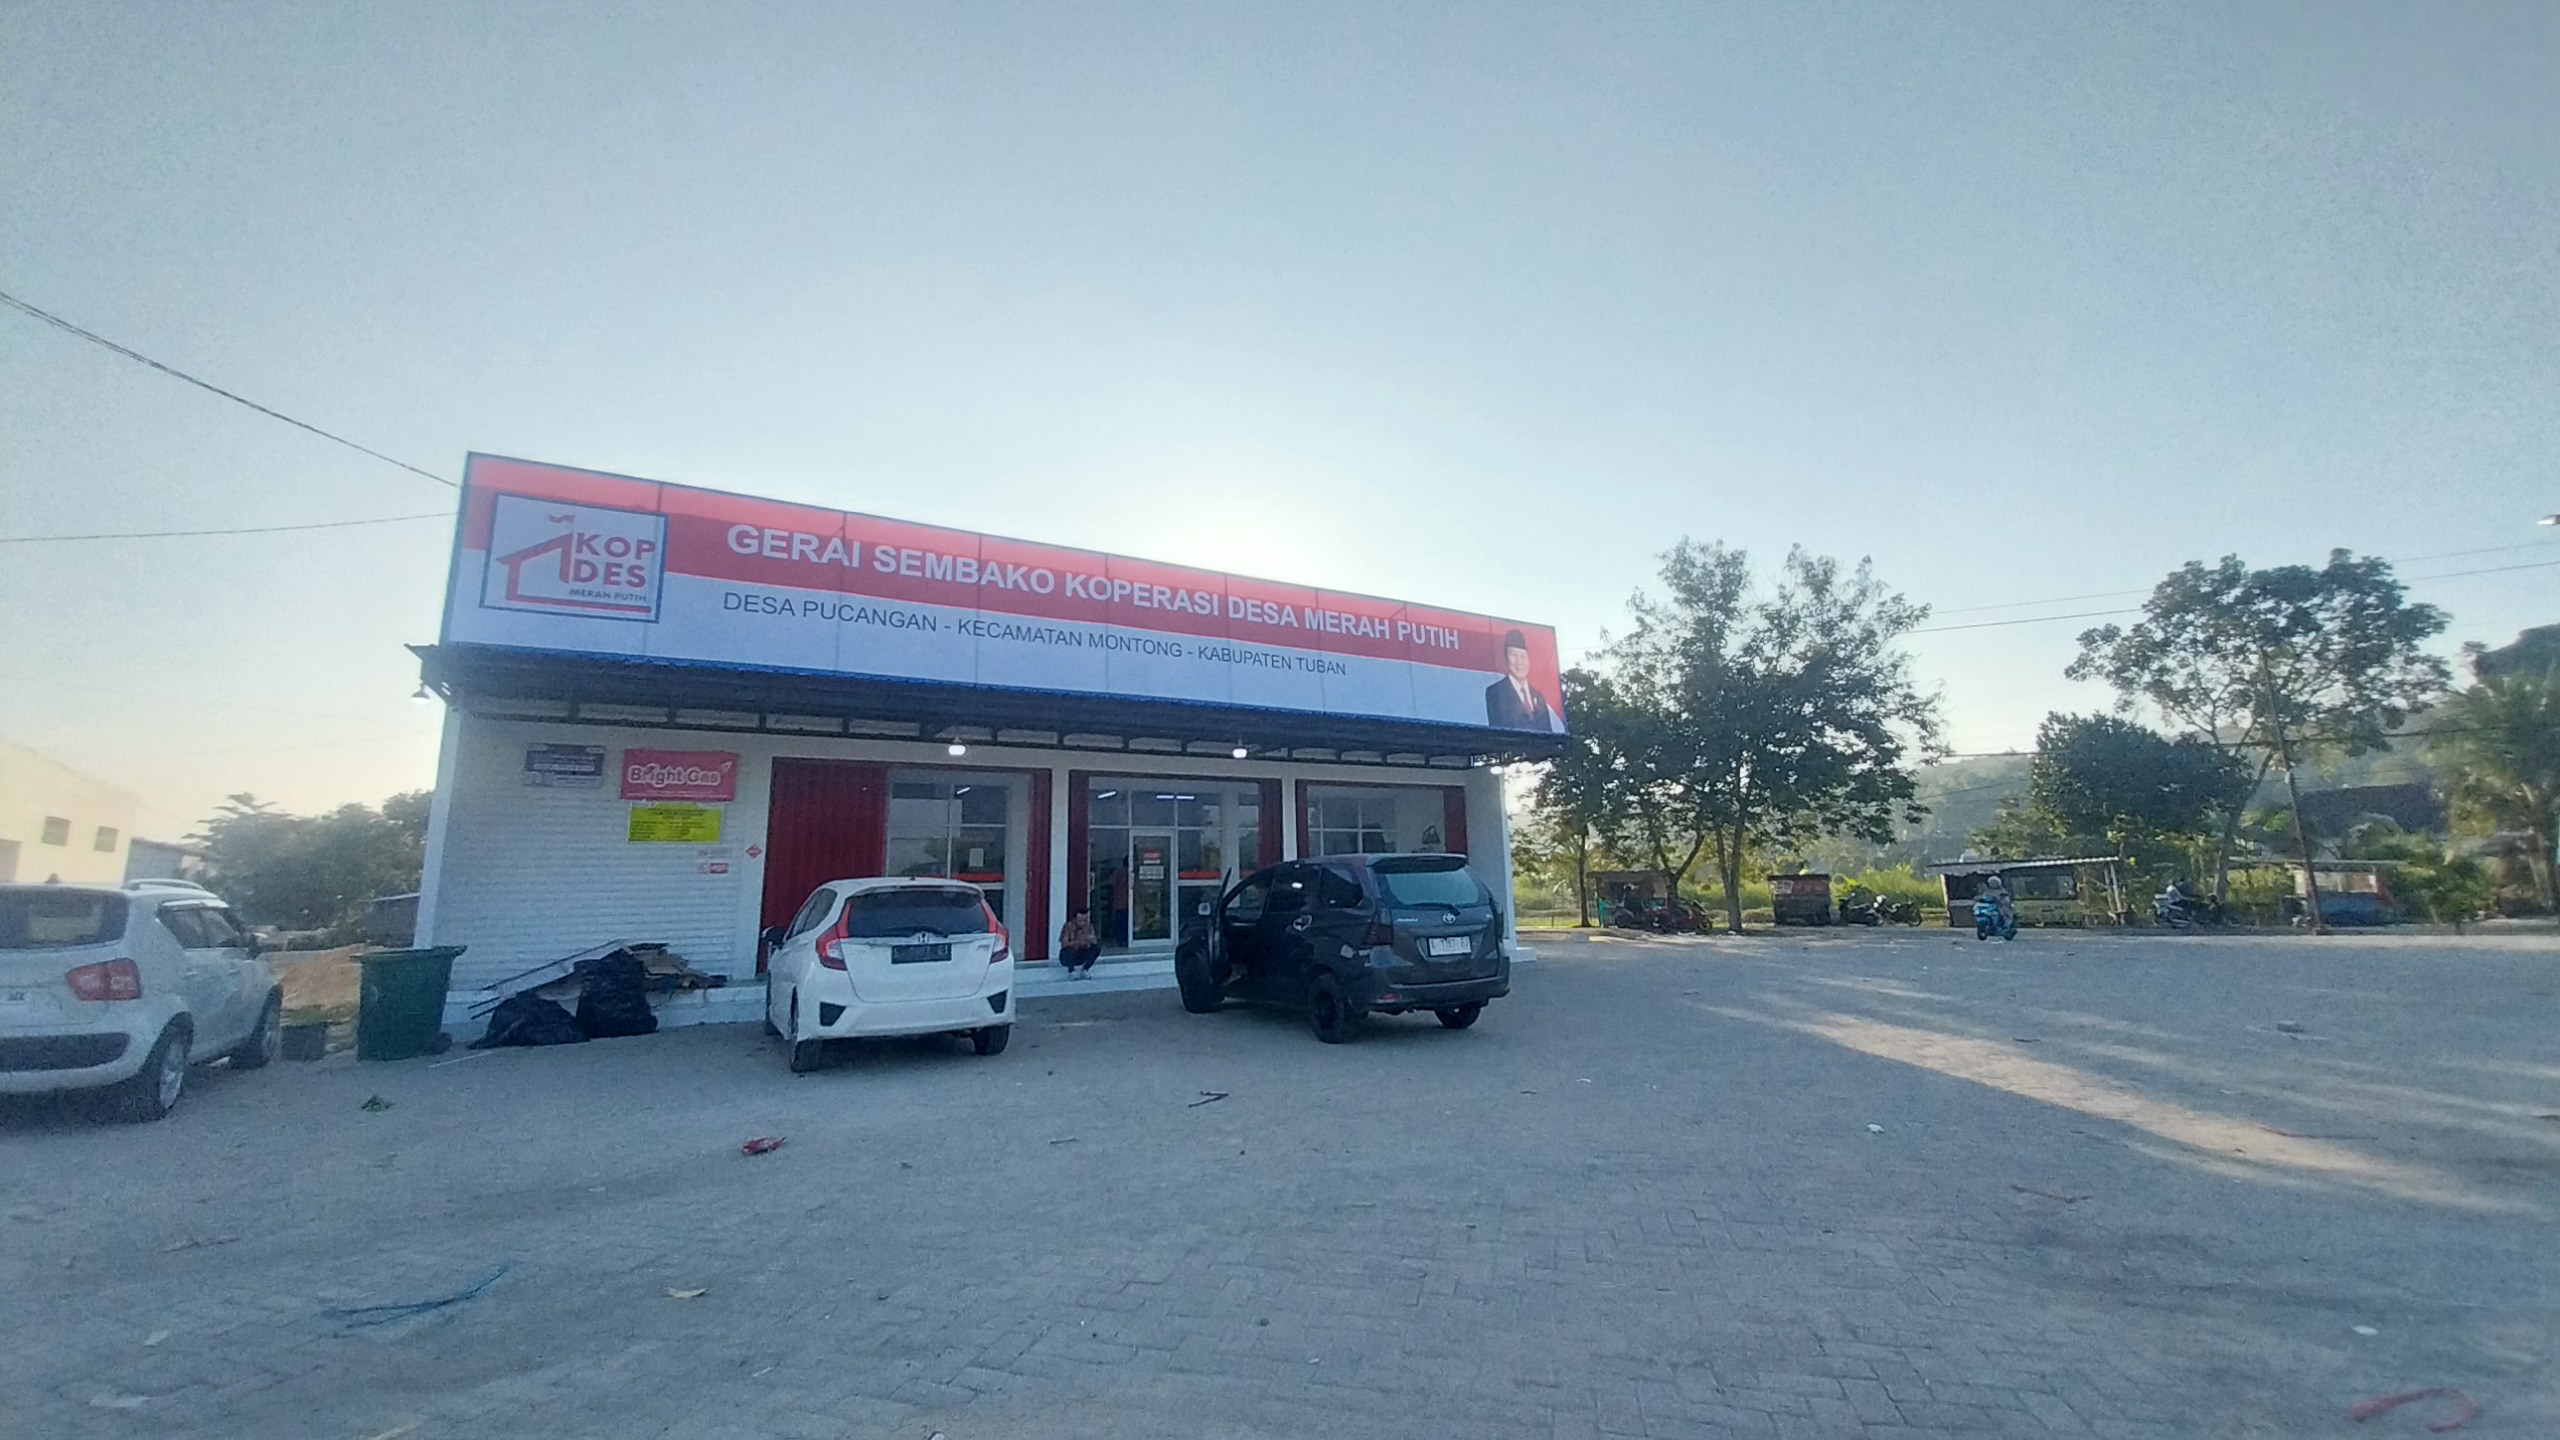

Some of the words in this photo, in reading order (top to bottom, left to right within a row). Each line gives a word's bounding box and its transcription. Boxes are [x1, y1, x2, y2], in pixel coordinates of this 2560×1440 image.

[576, 532, 656, 560] KOP
[572, 558, 647, 588] DES
[727, 524, 861, 568] GERAI
[873, 545, 1055, 595] SEMBAKO
[1065, 572, 1220, 617] KOPERASI
[1228, 596, 1299, 628] DESA
[1304, 607, 1390, 640] MERAH
[1397, 620, 1460, 650] PUTIH
[569, 588, 611, 600] MERAH
[614, 591, 647, 602] PUTIH
[723, 592, 796, 617] DESA
[803, 600, 938, 631] PUCANGAN
[958, 618, 1082, 647] KECAMATAN
[1089, 633, 1182, 658] MONTONG
[1198, 645, 1292, 669] KABUPATEN
[1296, 656, 1346, 675] TUBAN
[629, 764, 685, 788] Bright
[686, 767, 721, 786] Gas
